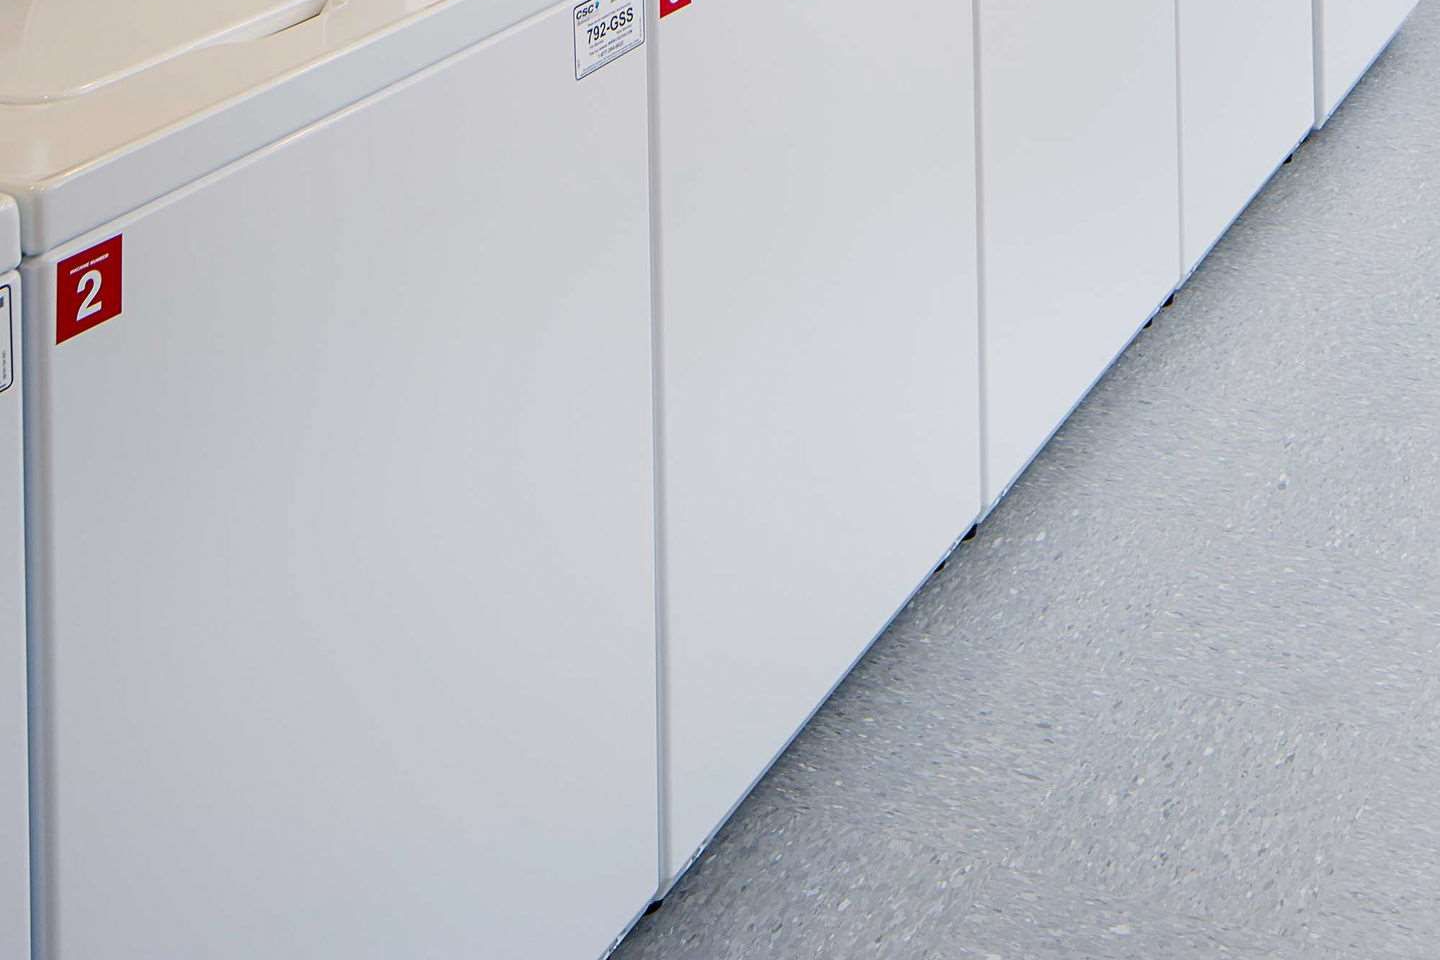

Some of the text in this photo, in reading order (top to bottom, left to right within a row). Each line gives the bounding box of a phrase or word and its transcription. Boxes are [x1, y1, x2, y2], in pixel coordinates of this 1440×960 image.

[575, 4, 594, 20] CSC
[586, 7, 634, 45] 792-GSS
[76, 269, 102, 322] 2
